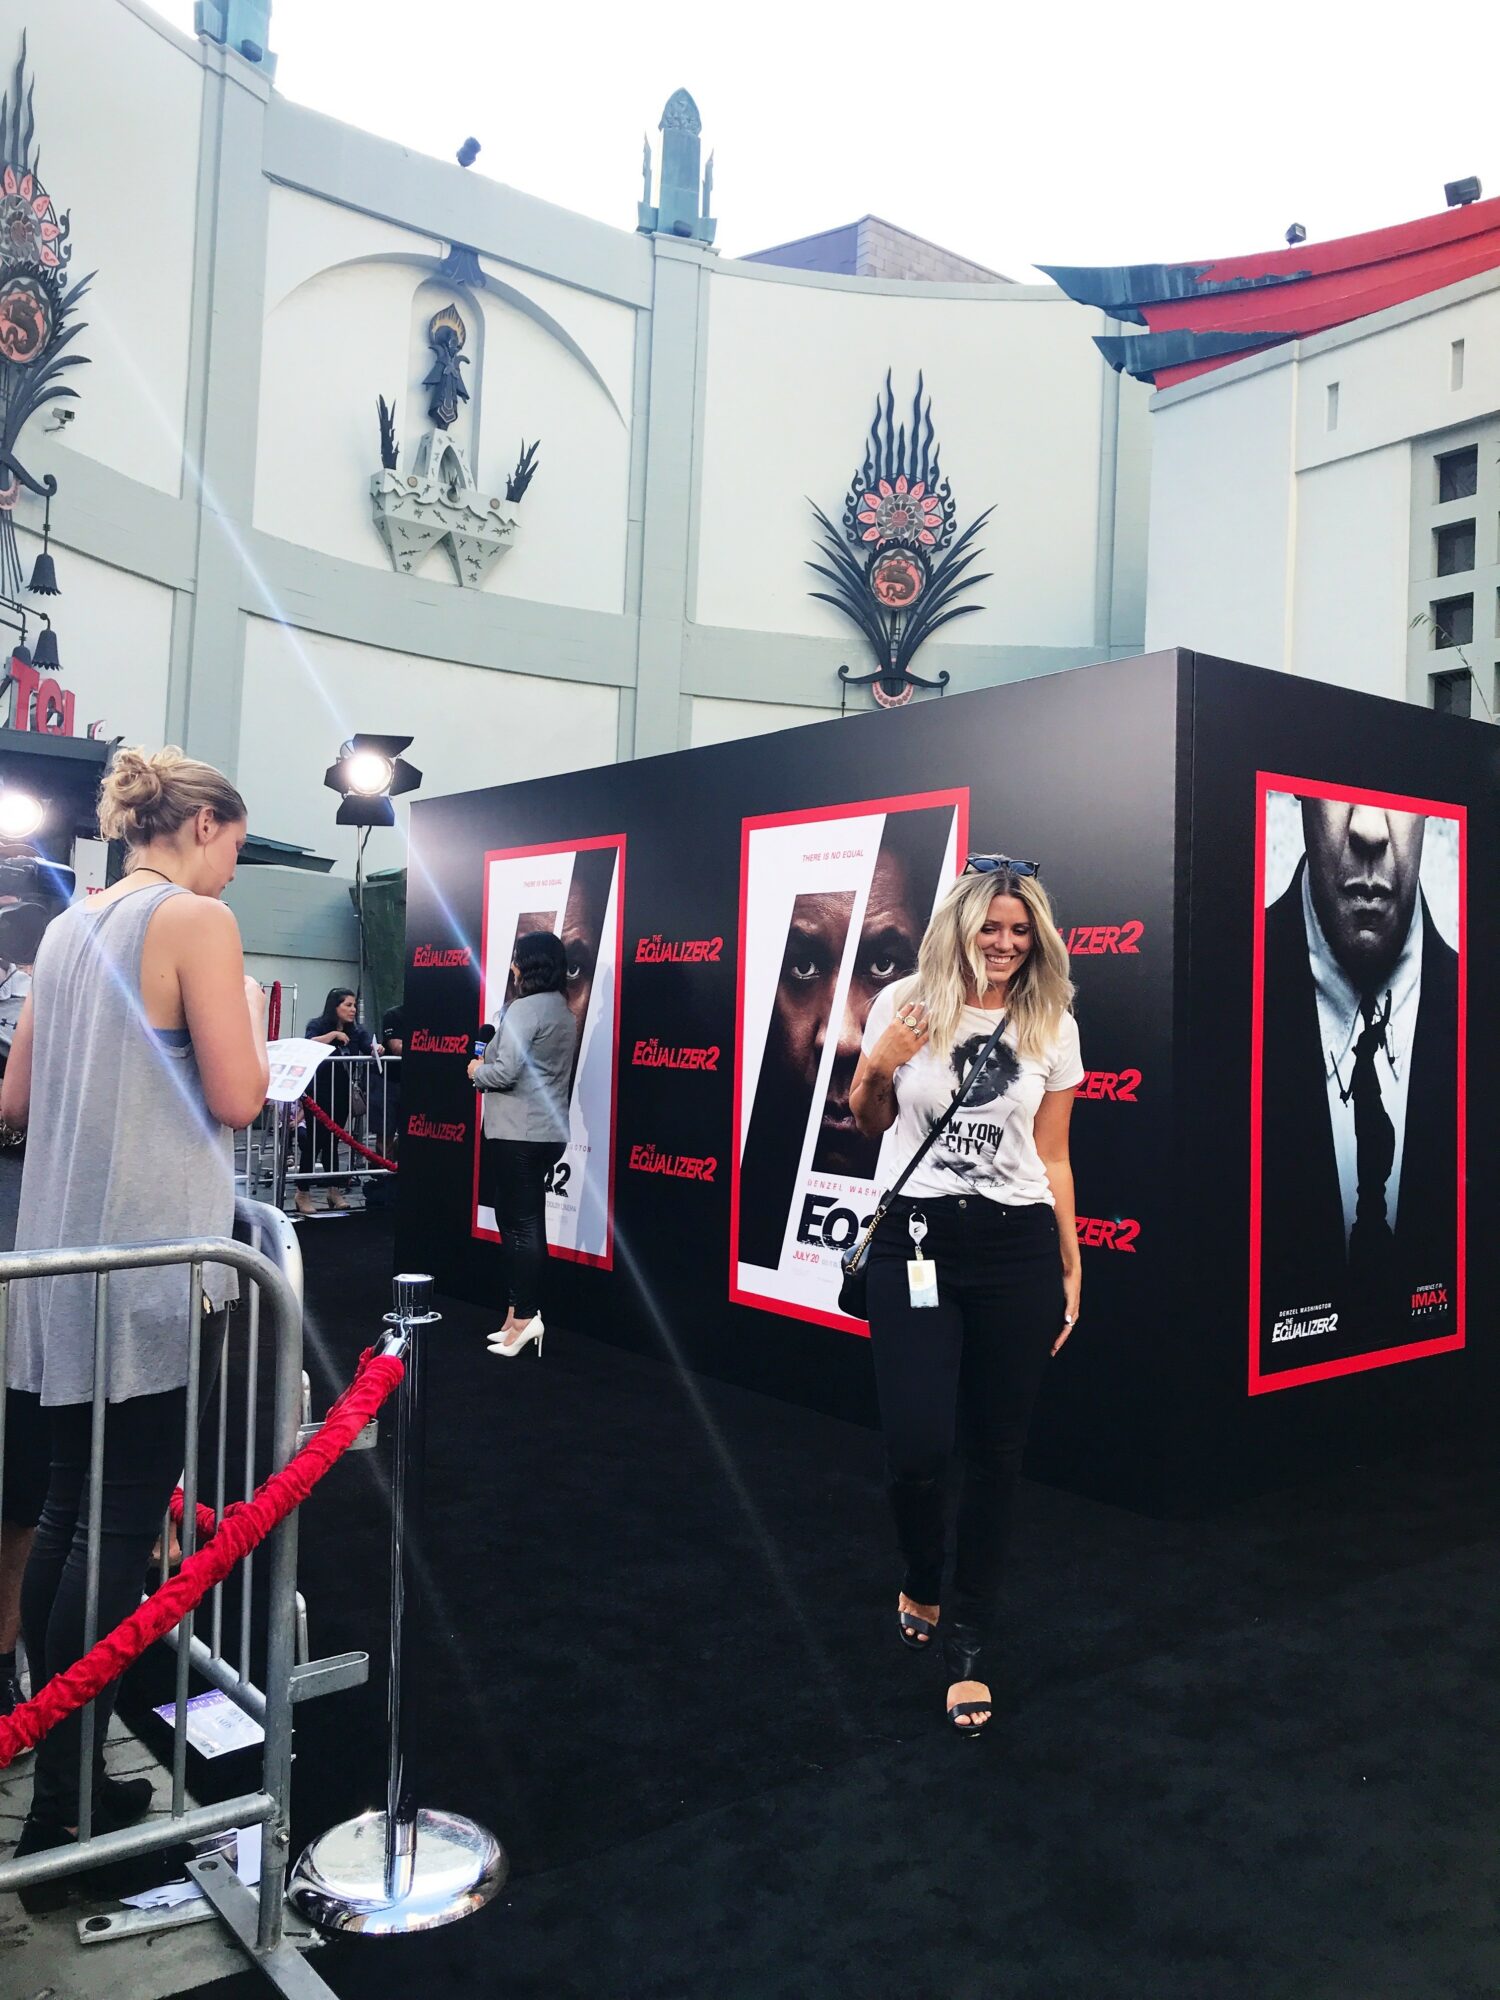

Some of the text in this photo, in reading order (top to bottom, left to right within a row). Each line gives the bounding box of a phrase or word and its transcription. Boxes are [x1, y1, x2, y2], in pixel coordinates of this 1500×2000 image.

[823, 852, 830, 860] IS
[831, 851, 841, 860] NO
[842, 849, 864, 858] EQUAL
[945, 1134, 985, 1155] CITY
[807, 1179, 881, 1198] DENZEL WASHI
[792, 1250, 811, 1261] JULY
[810, 1253, 820, 1264] 20
[1411, 1288, 1448, 1309] IMAX
